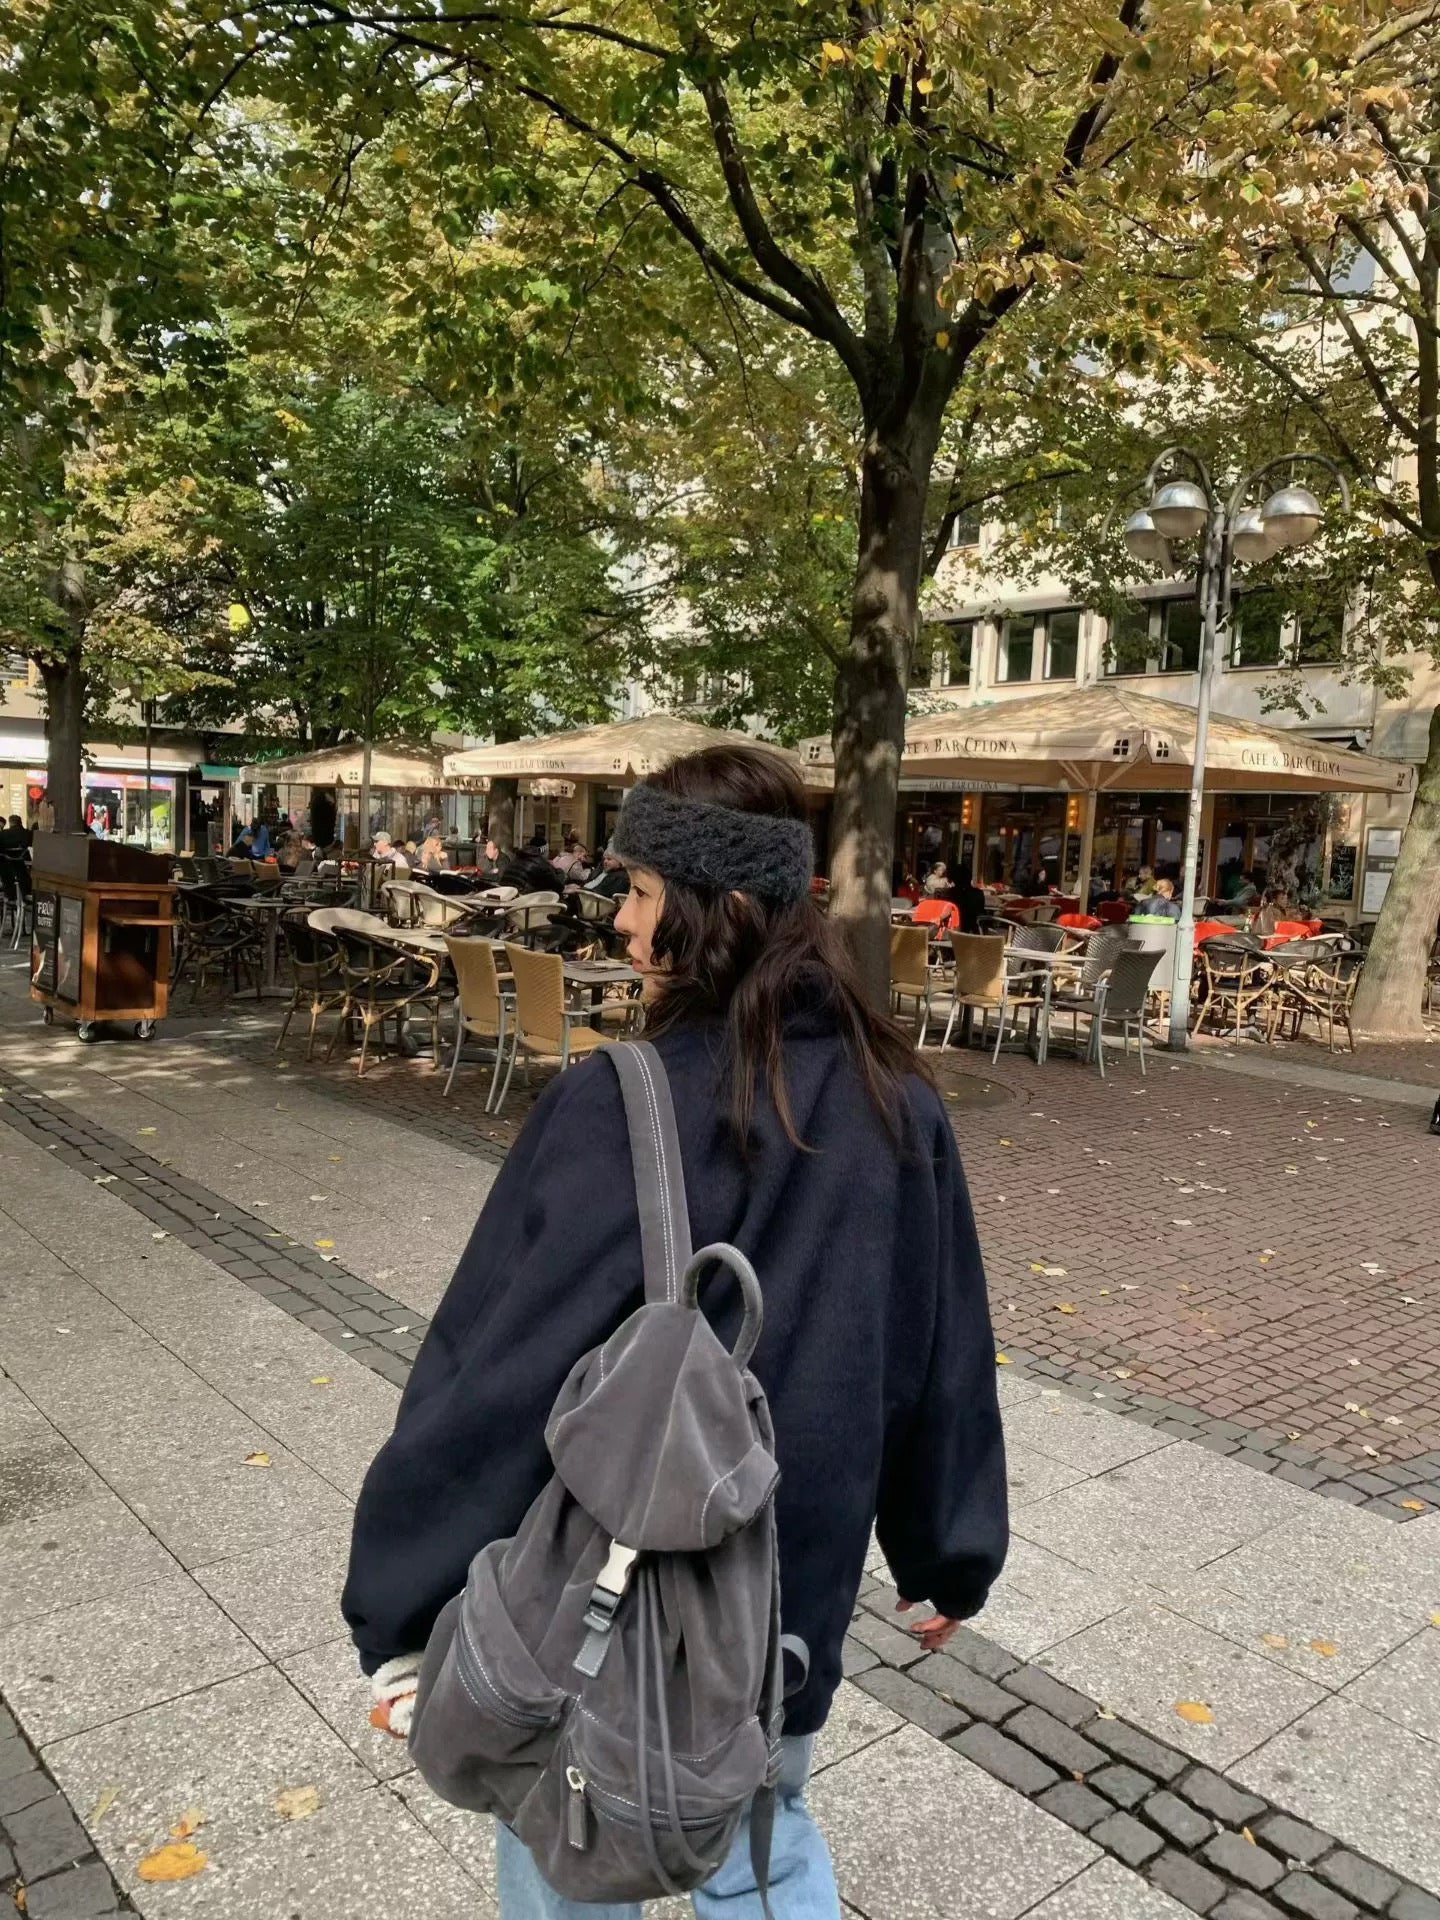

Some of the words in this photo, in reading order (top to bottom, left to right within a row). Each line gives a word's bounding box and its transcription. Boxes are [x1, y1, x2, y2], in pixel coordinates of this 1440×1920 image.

[934, 738, 960, 752] BAR
[964, 737, 1017, 753] CELONA
[1241, 749, 1268, 766] CAFE
[1272, 755, 1279, 767] &
[1282, 752, 1303, 769] BAR
[1305, 755, 1342, 777] CELONA
